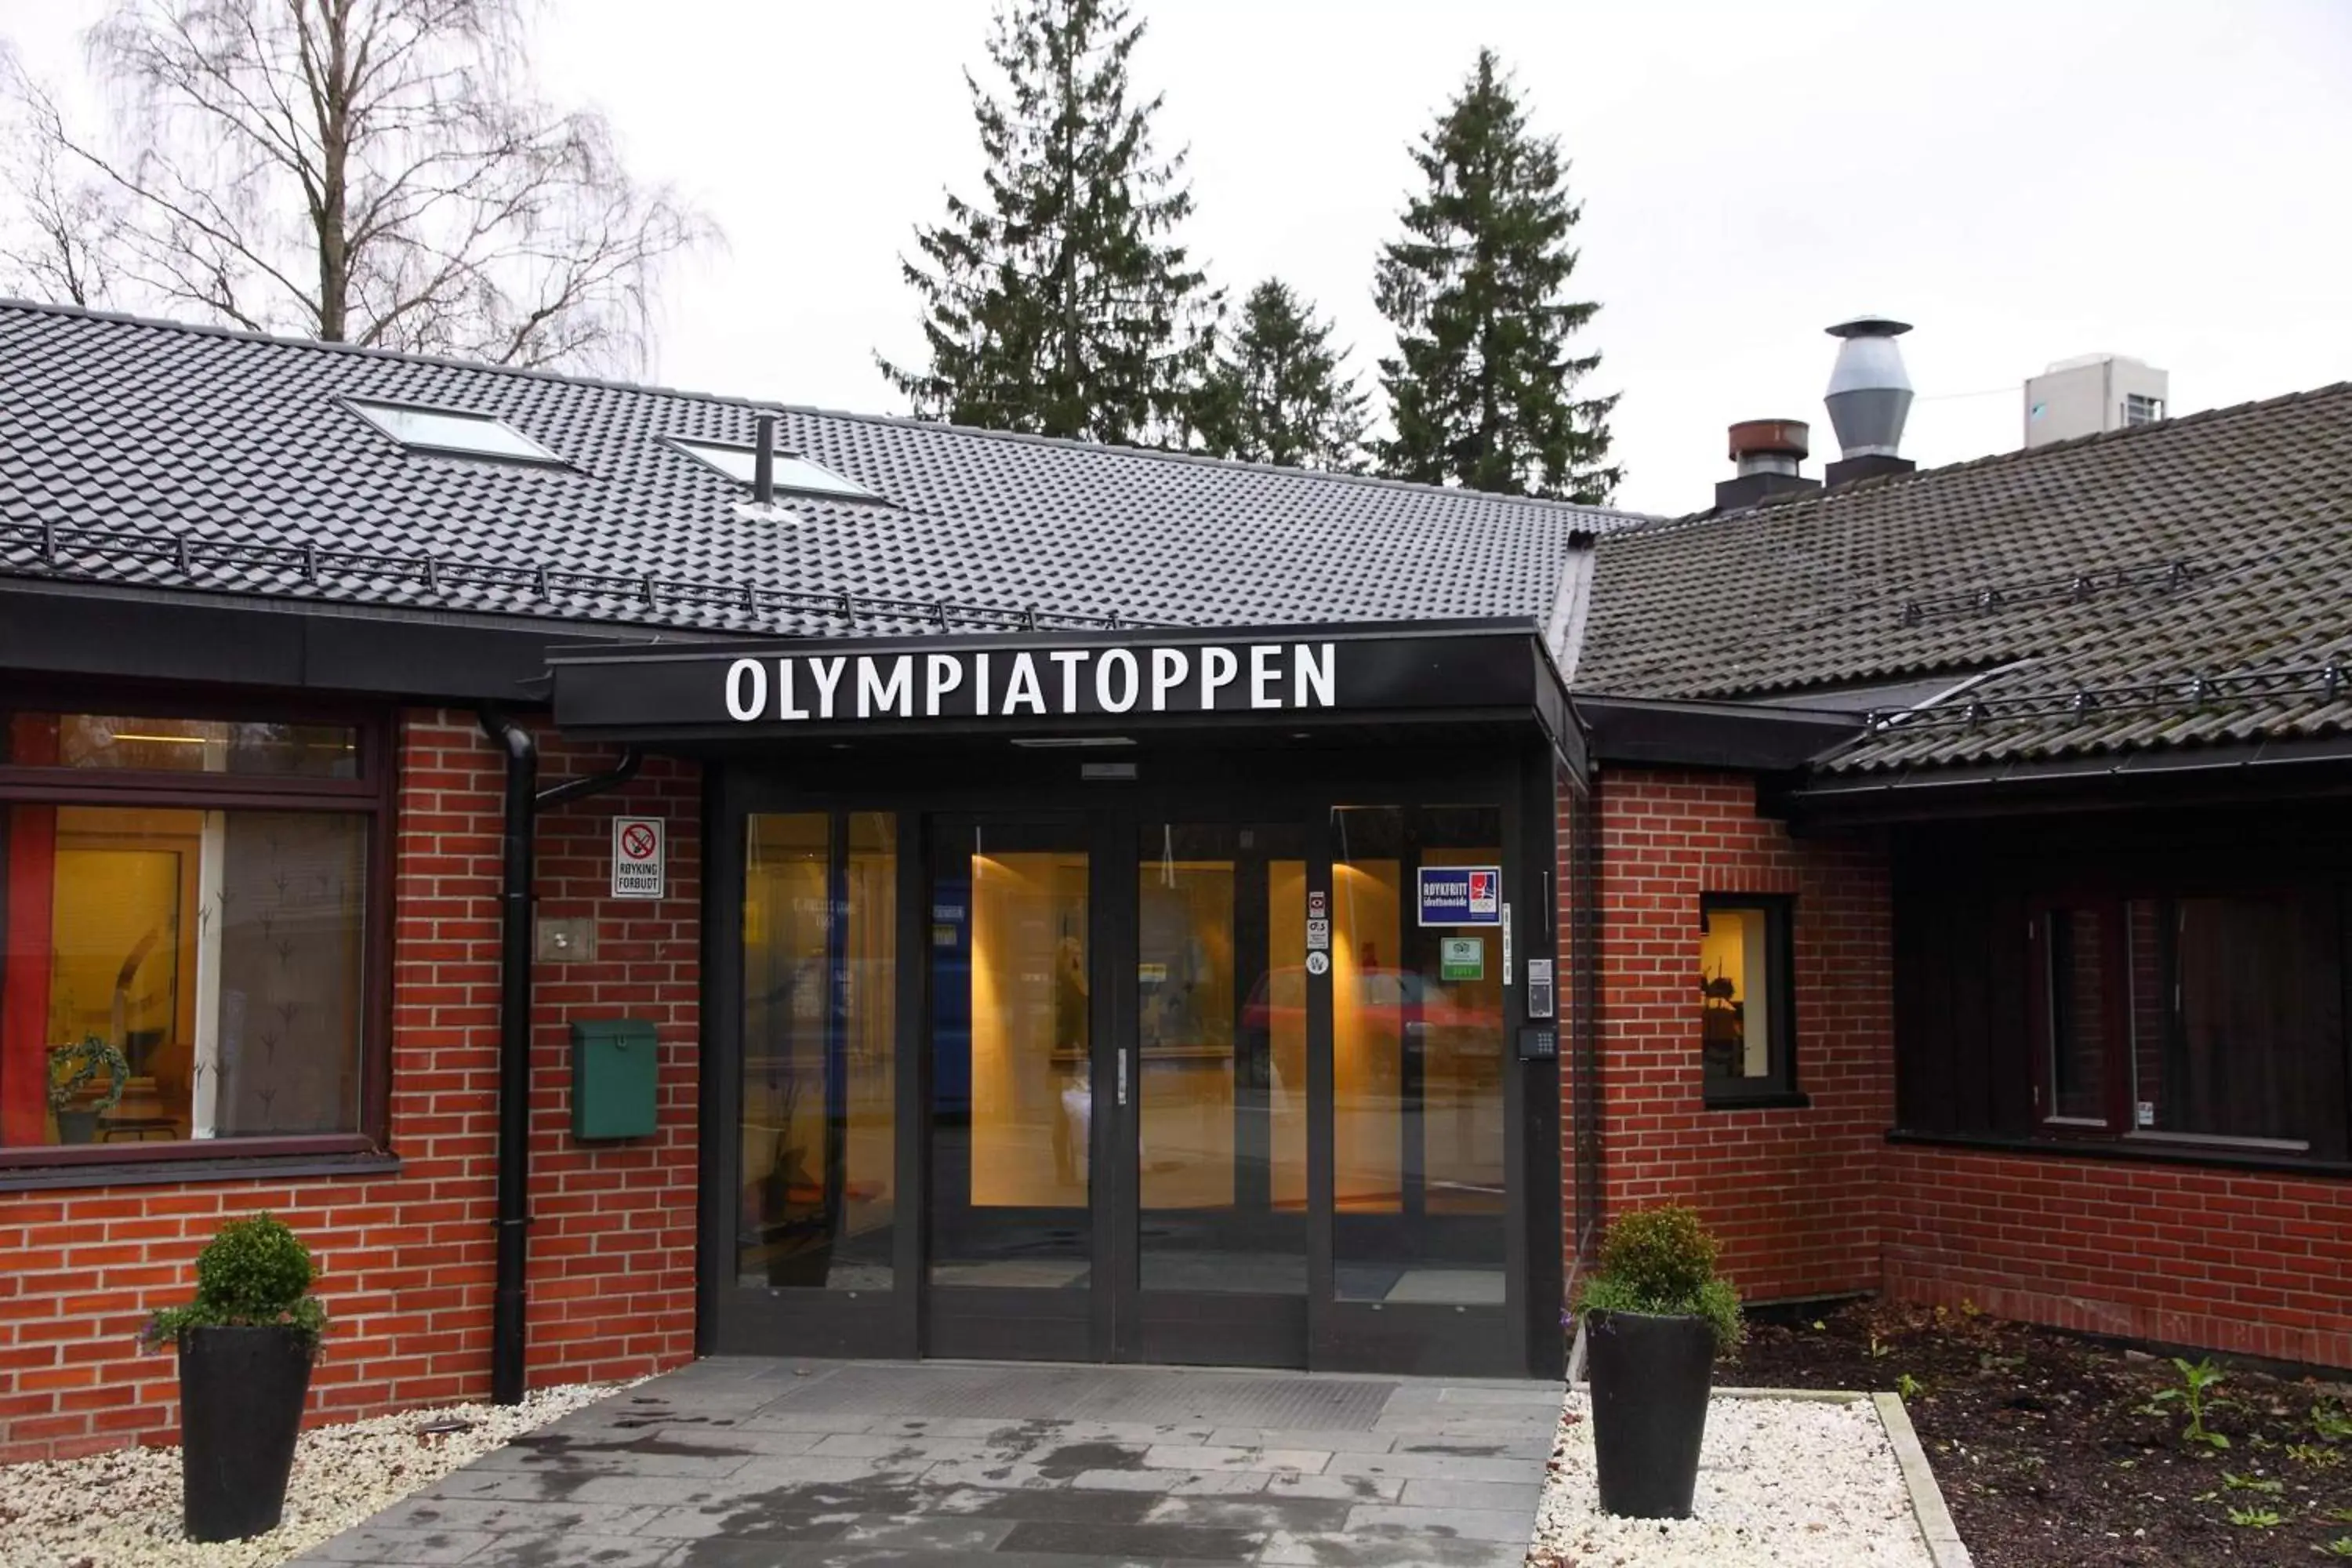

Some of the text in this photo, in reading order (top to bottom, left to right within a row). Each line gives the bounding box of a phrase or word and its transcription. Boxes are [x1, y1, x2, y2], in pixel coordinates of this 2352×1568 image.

[724, 644, 1336, 721] OLYMPIATOPPEN
[619, 863, 658, 875] RØYKING
[619, 877, 658, 889] FORBUDT
[1309, 921, 1326, 931] GS
